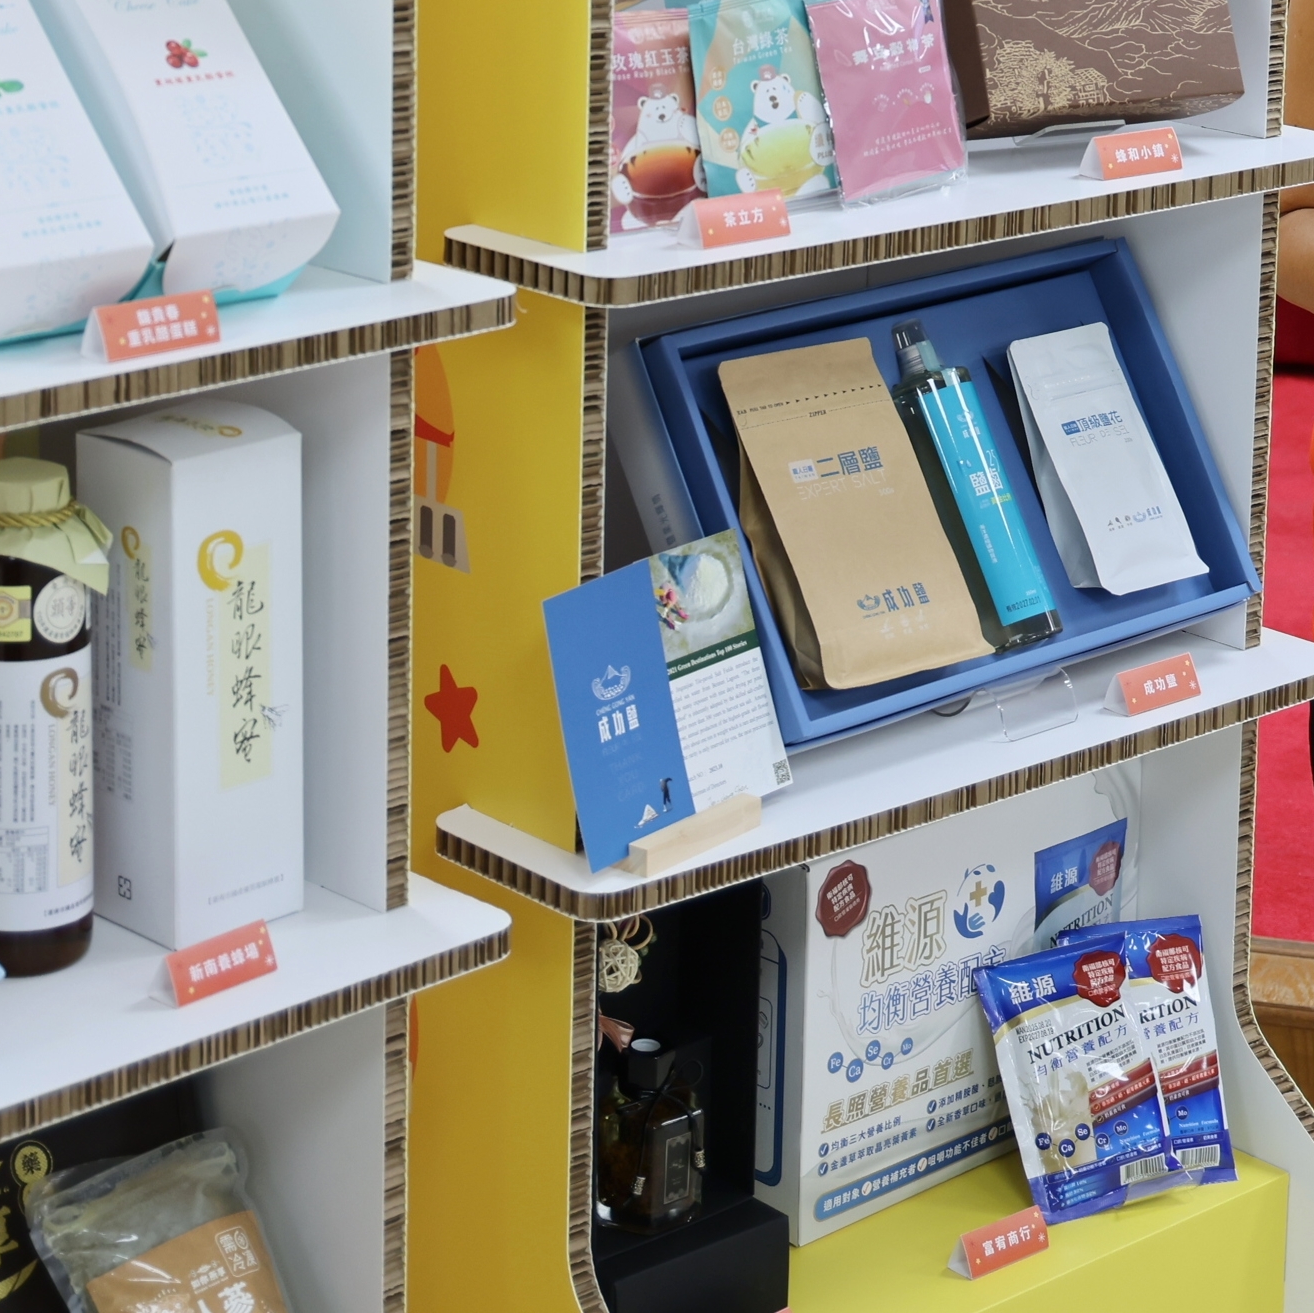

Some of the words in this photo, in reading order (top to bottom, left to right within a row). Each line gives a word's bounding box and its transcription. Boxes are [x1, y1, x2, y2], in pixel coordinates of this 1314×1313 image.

[732, 26, 790, 56] 台灣綠茶
[1115, 143, 1166, 164] 蜂和小鎮
[722, 207, 766, 229] 茶立方
[1077, 410, 1124, 432] 頂級鹽花
[816, 446, 884, 478] 二層鹽
[796, 476, 848, 501] EXPERT
[849, 468, 889, 491] SALT
[882, 582, 931, 613] 成功鹽
[227, 579, 265, 764] 龍眼蜂蜜
[1143, 673, 1178, 696] 成功鹽
[598, 704, 640, 744] 成功鹽
[861, 890, 948, 988] 維源
[189, 942, 259, 982] 新南養蜂場
[1010, 973, 1057, 1005] 維源
[1029, 1004, 1127, 1064] NUTRITION
[868, 1045, 879, 1056] Se
[902, 1042, 912, 1052] Mo
[830, 1057, 842, 1068] Fe
[848, 1064, 862, 1077] Ca
[882, 1056, 893, 1066] Cr
[824, 1048, 974, 1131] 長照營養品首選
[1177, 1109, 1188, 1117] Mo
[830, 1115, 902, 1152] 均衡三大營養比例
[1037, 1132, 1051, 1145] Fe
[1077, 1126, 1088, 1137] Se
[1116, 1122, 1128, 1132] Mo
[1060, 1142, 1074, 1154] Ca
[1098, 1136, 1108, 1146] Cr
[823, 1188, 861, 1213] 適用對象
[872, 1163, 917, 1192] 營養補充者
[926, 1133, 988, 1167] 咀嚼功能不佳者
[982, 1225, 1031, 1257] 富宥商行
